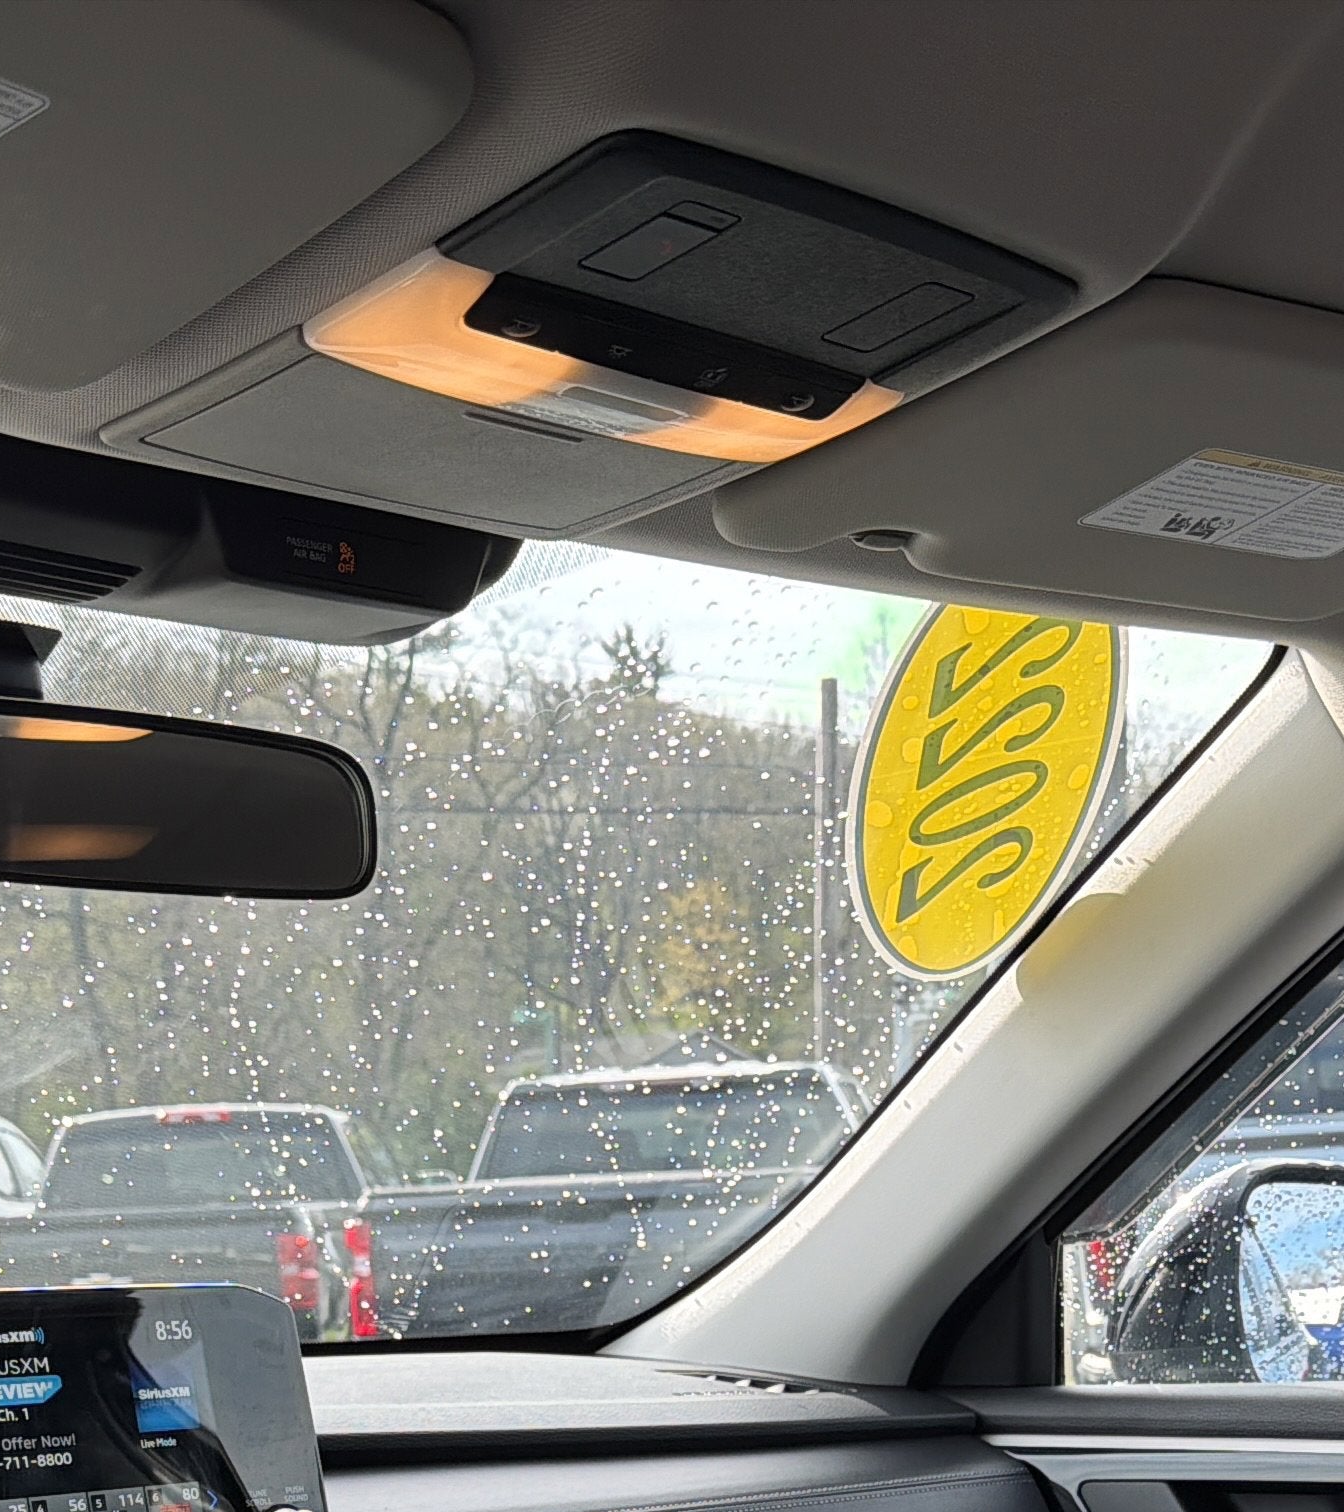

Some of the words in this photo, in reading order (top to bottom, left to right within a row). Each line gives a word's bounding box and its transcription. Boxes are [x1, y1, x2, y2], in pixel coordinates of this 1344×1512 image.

[286, 536, 333, 553] PASSENGER
[337, 562, 355, 574] OFF
[155, 1319, 193, 1341] 8:56
[138, 1385, 191, 1401] SiriusXM
[22, 1408, 30, 1421] 1
[1, 1436, 38, 1452] Offer
[40, 1432, 77, 1449] Now!
[140, 1437, 156, 1449] Live
[156, 1436, 177, 1448] Mode
[182, 1487, 200, 1501] 80
[284, 1484, 305, 1495] PUSH
[68, 1498, 87, 1512] 56
[95, 1499, 103, 1509] 5
[118, 1493, 144, 1508] 114
